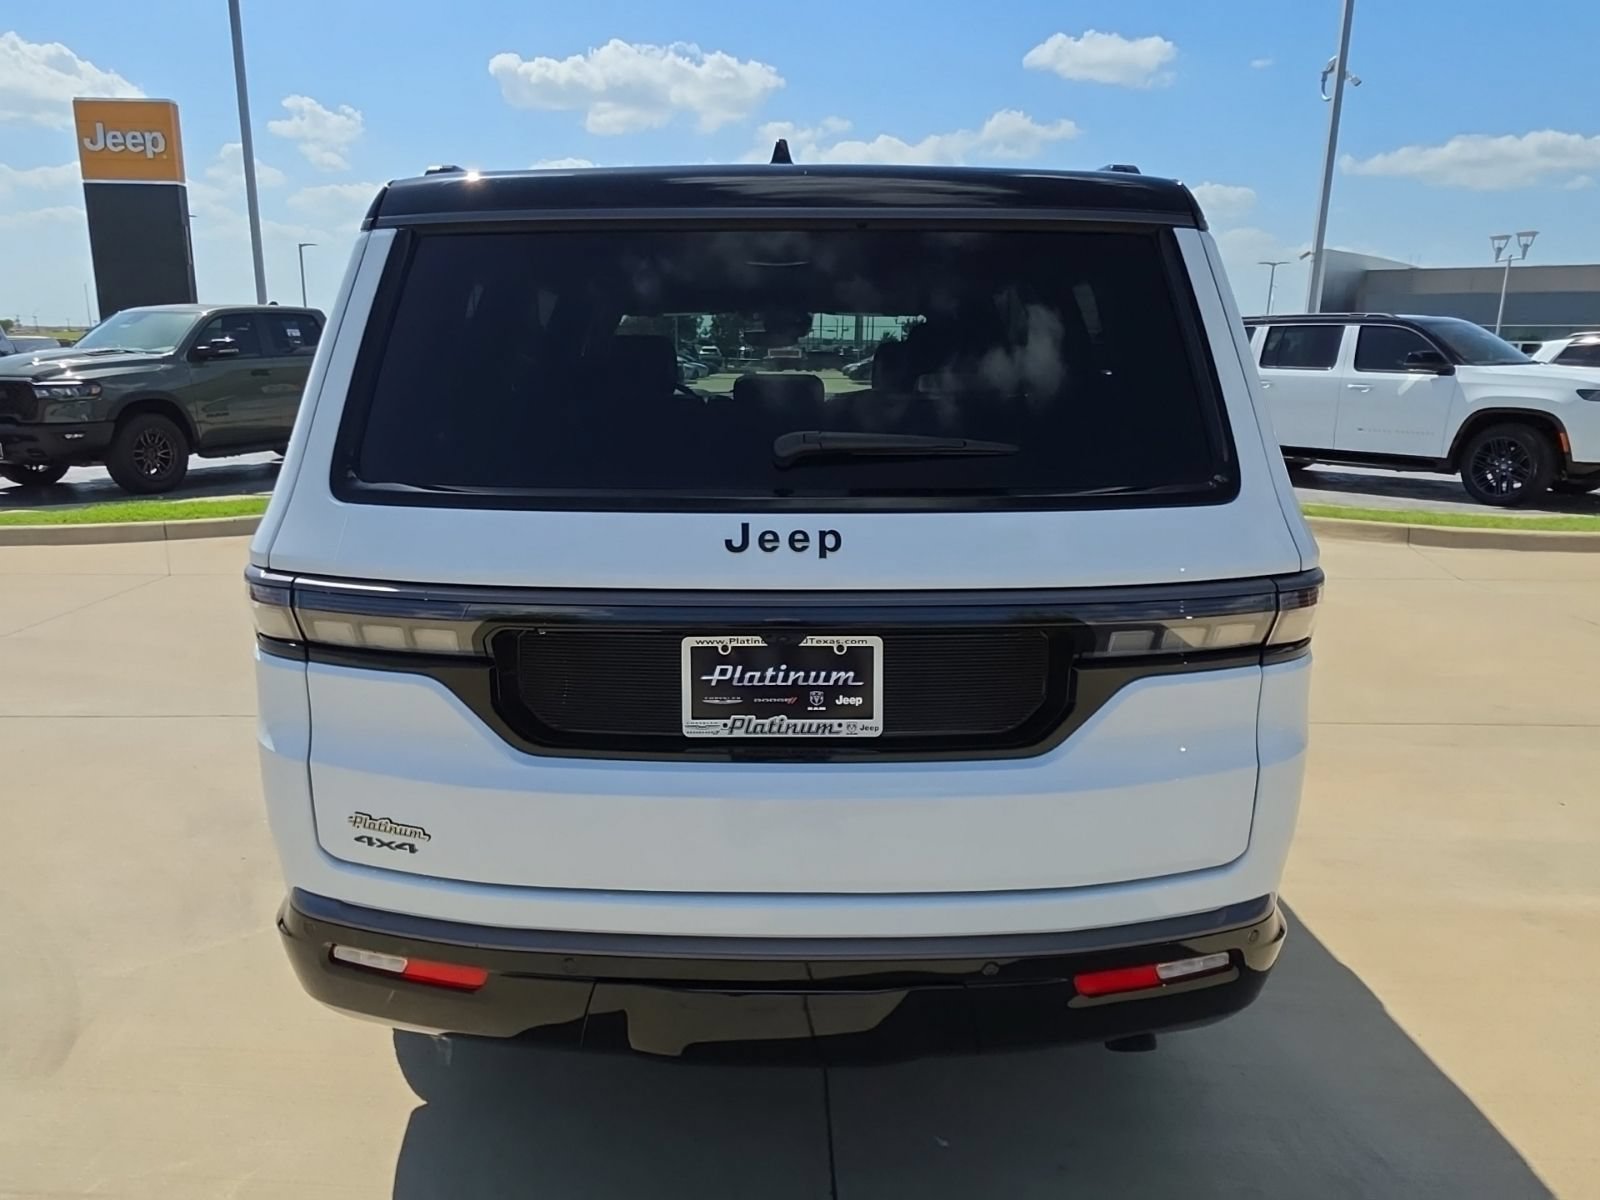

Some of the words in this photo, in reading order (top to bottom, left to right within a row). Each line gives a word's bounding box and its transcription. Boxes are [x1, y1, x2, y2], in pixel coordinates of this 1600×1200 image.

[83, 122, 166, 158] Jeep
[724, 522, 842, 559] Jeep
[701, 664, 864, 686] Platinum
[835, 694, 863, 706] Jeep
[727, 717, 842, 736] Platinum
[859, 723, 880, 732] Jeep
[348, 812, 430, 841] Platinum
